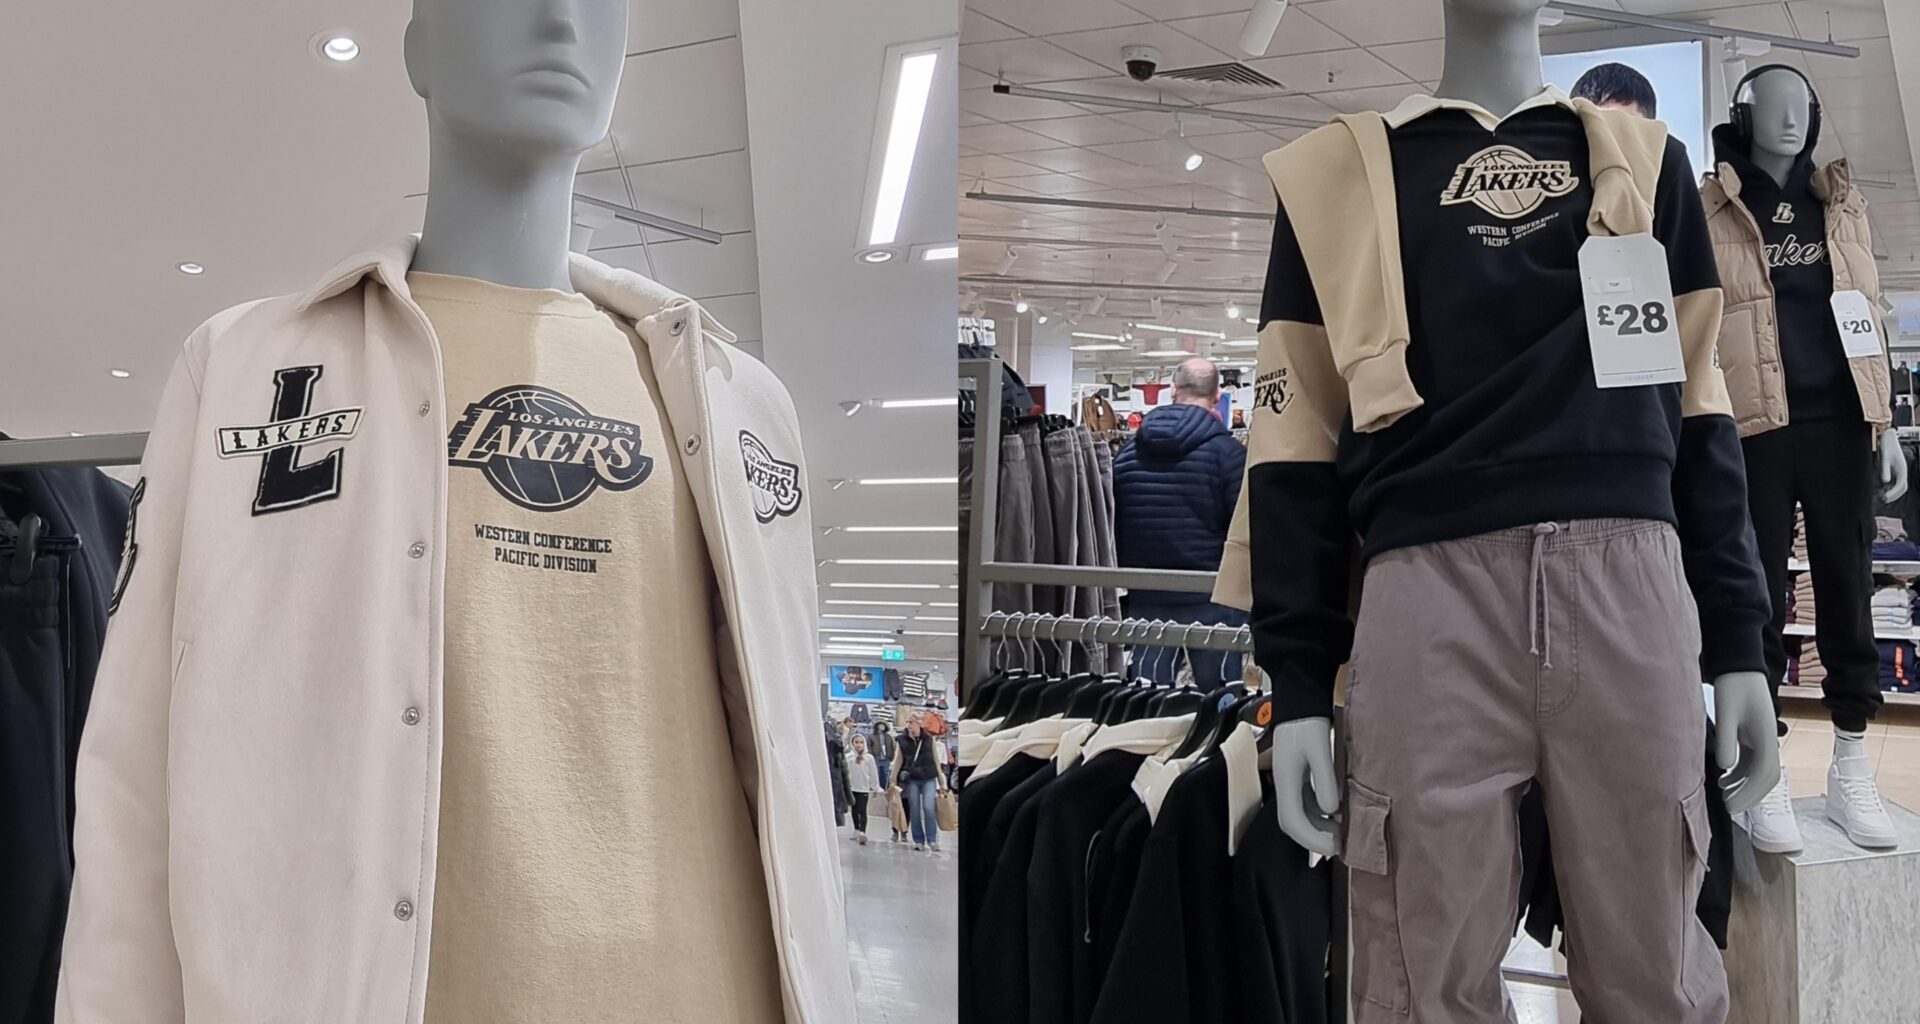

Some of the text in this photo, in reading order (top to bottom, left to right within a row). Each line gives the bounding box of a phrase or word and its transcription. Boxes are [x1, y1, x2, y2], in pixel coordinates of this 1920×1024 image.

[1483, 163, 1566, 172] LOS ANGELES
[1449, 166, 1574, 200] LAKERS
[1467, 225, 1507, 236] WESTERN
[1482, 236, 1510, 247] PACIFIC
[1597, 301, 1668, 336] £28
[1842, 319, 1872, 334] £20
[1253, 380, 1294, 414] ERS
[232, 414, 347, 450] LAKERS
[508, 412, 635, 436] LOS ANGELES
[251, 365, 344, 517] L
[449, 407, 647, 484] LAKERS
[756, 460, 792, 477] ANGELES
[474, 523, 612, 553] WESTERN CONFERENCE
[494, 546, 597, 574] PACIFIC DIVISION
